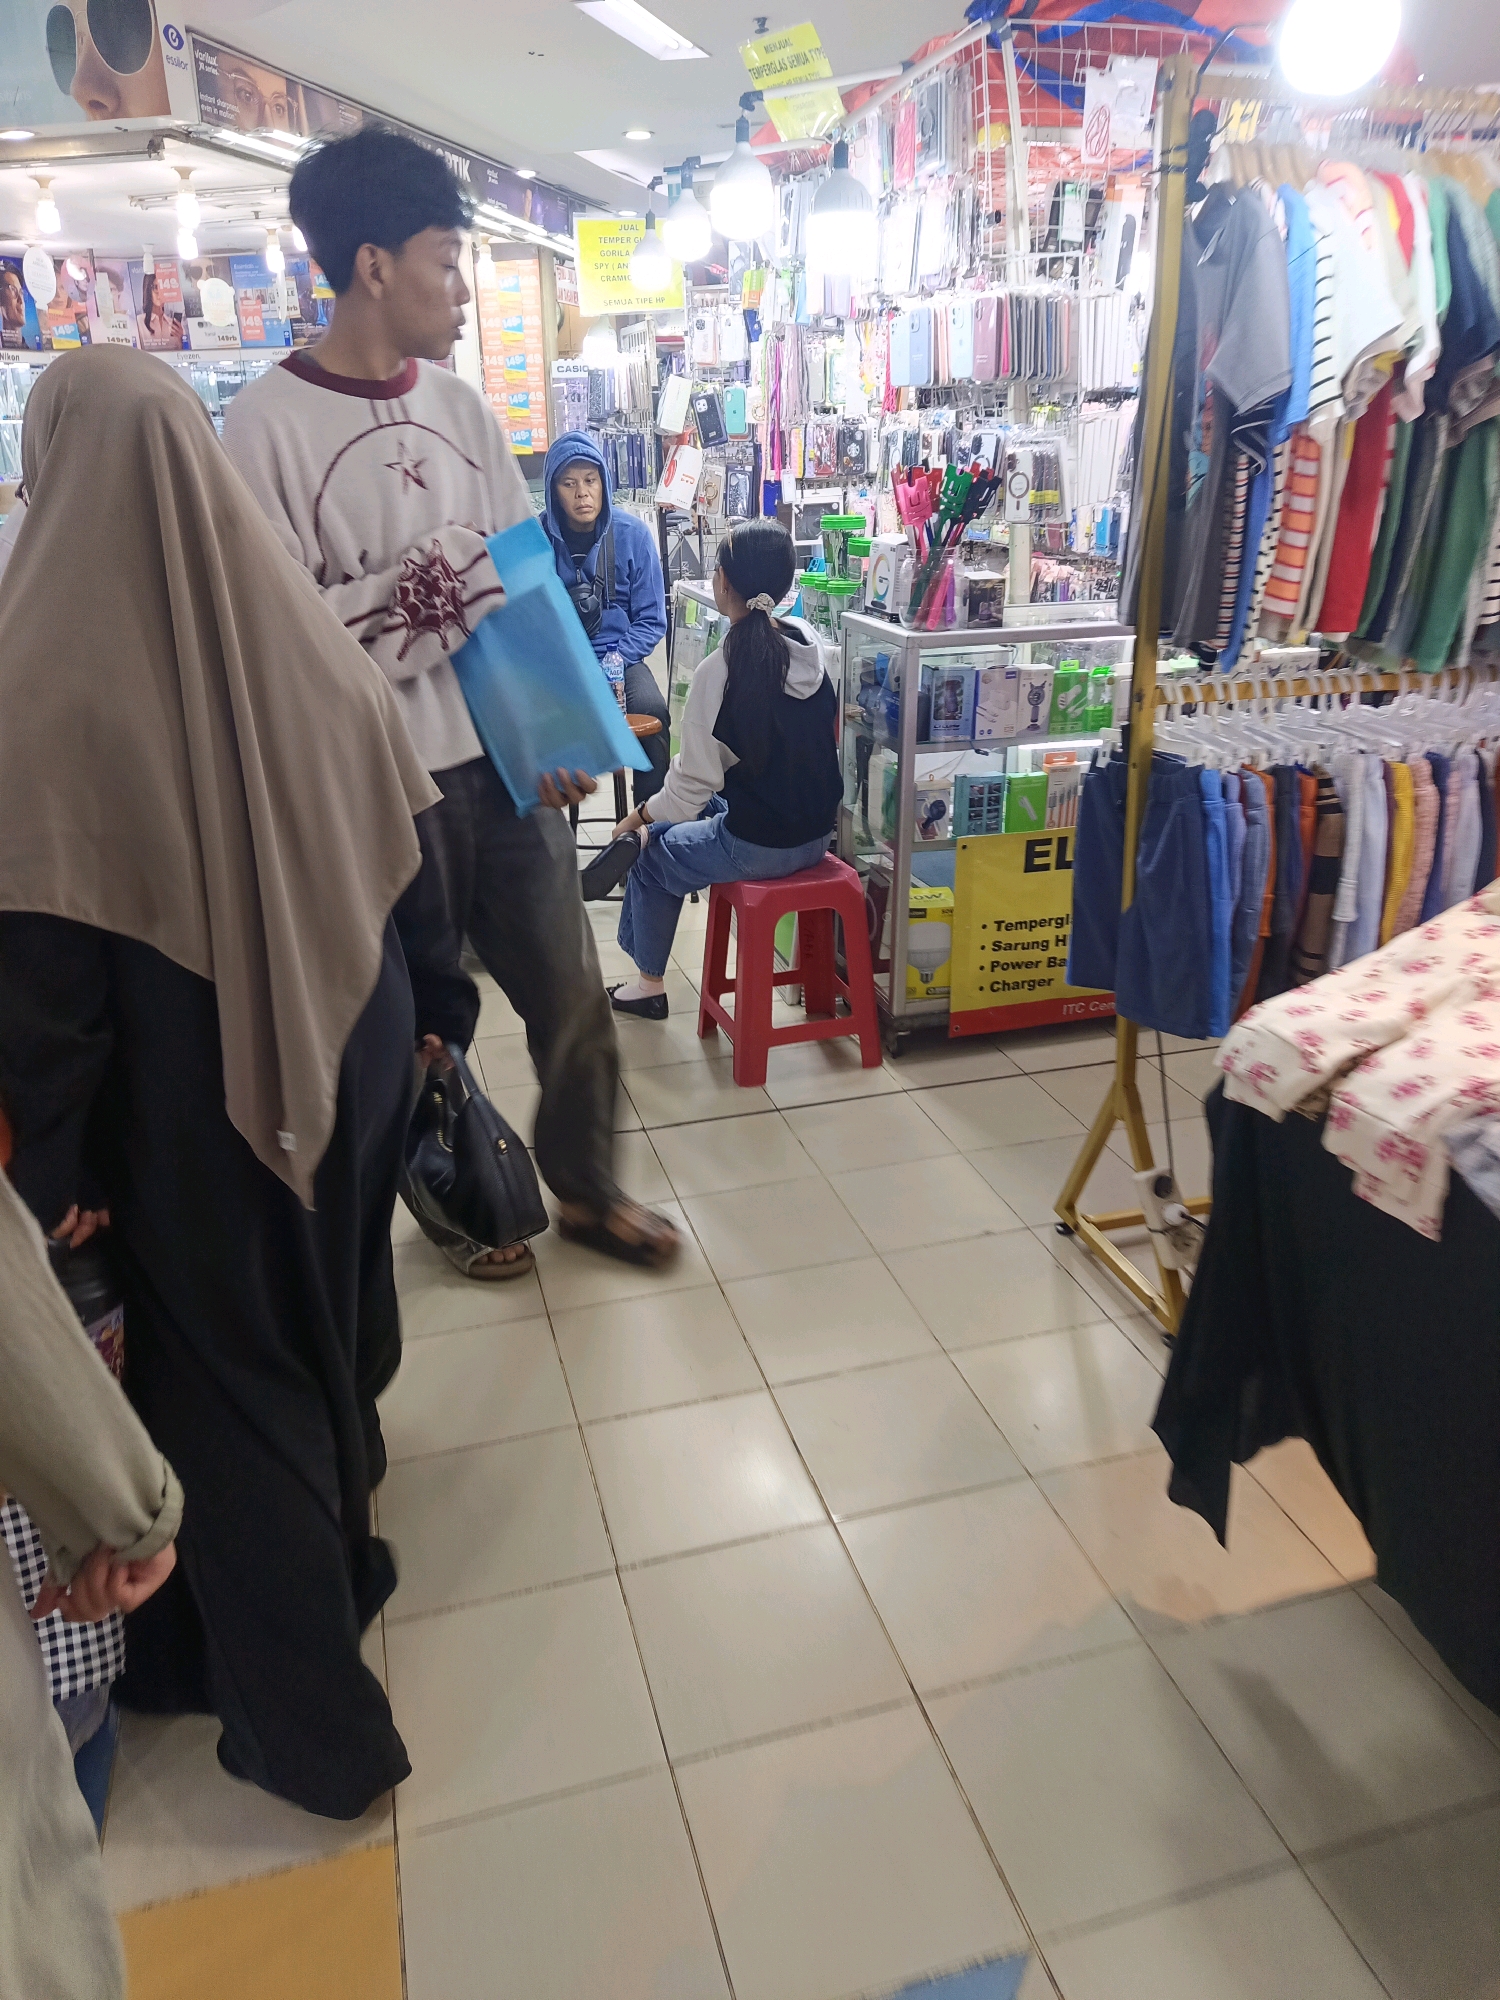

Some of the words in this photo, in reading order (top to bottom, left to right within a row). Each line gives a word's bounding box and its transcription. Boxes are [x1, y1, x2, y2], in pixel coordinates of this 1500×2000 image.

[764, 38, 793, 54] MENJUAL
[165, 54, 189, 70] essilor
[748, 61, 789, 80] TEMPERGLAS
[787, 51, 810, 70] SEMUA
[809, 47, 827, 62] TYPE
[200, 103, 213, 114] even
[598, 236, 632, 244] TEMPER
[594, 262, 610, 270] SPY
[603, 298, 634, 306] SEMUA
[0, 353, 20, 361] Nikon
[556, 365, 589, 373] CASIO
[993, 913, 1073, 932] Tempergl
[991, 939, 1050, 952] Sarung
[1055, 933, 1068, 947] H
[990, 960, 1043, 973] Power
[1046, 956, 1068, 968] Ba
[989, 978, 1055, 993] Charger
[1062, 1002, 1086, 1016] ITC
[1089, 1001, 1116, 1012] Cen
